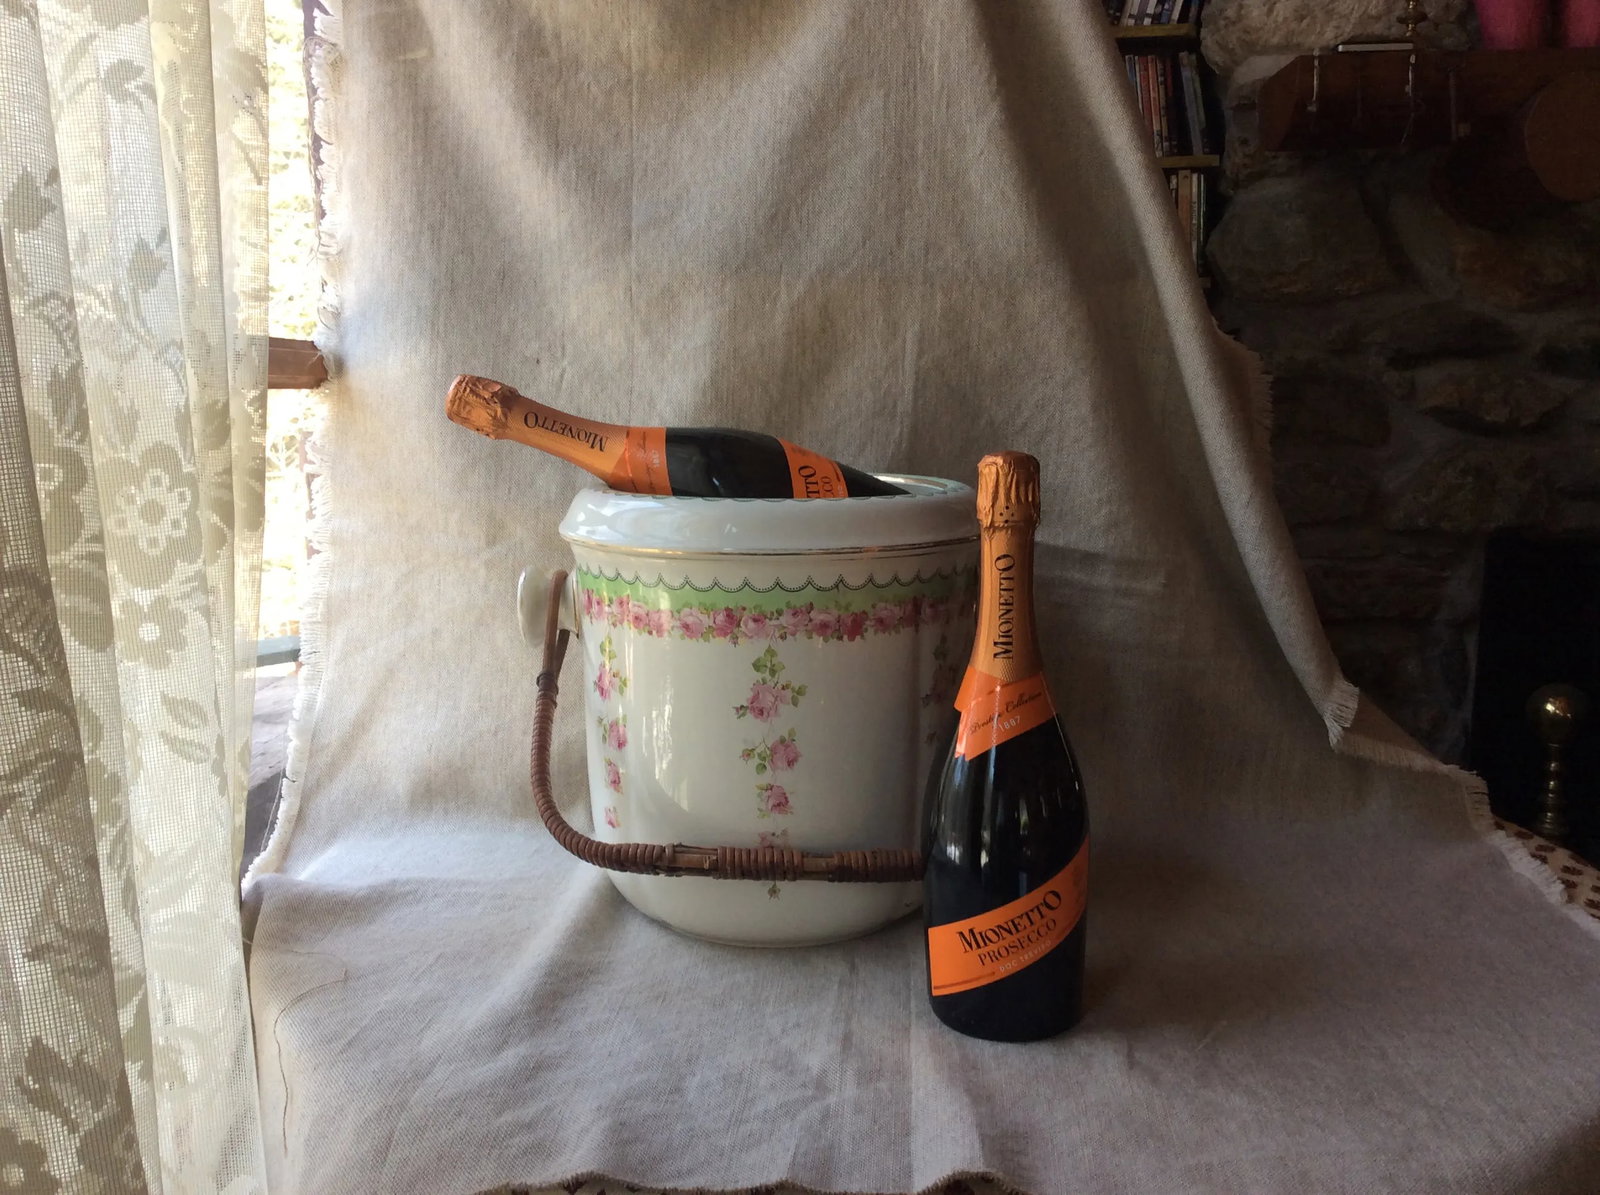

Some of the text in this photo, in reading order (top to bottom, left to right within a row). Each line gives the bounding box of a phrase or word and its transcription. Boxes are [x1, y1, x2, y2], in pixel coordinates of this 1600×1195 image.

[523, 411, 609, 453] MIONETTO
[993, 553, 1016, 661] MIONETTO
[998, 715, 1021, 733] 1887
[957, 890, 1062, 953] MIONETTO
[977, 918, 1057, 966] PROSECCO
